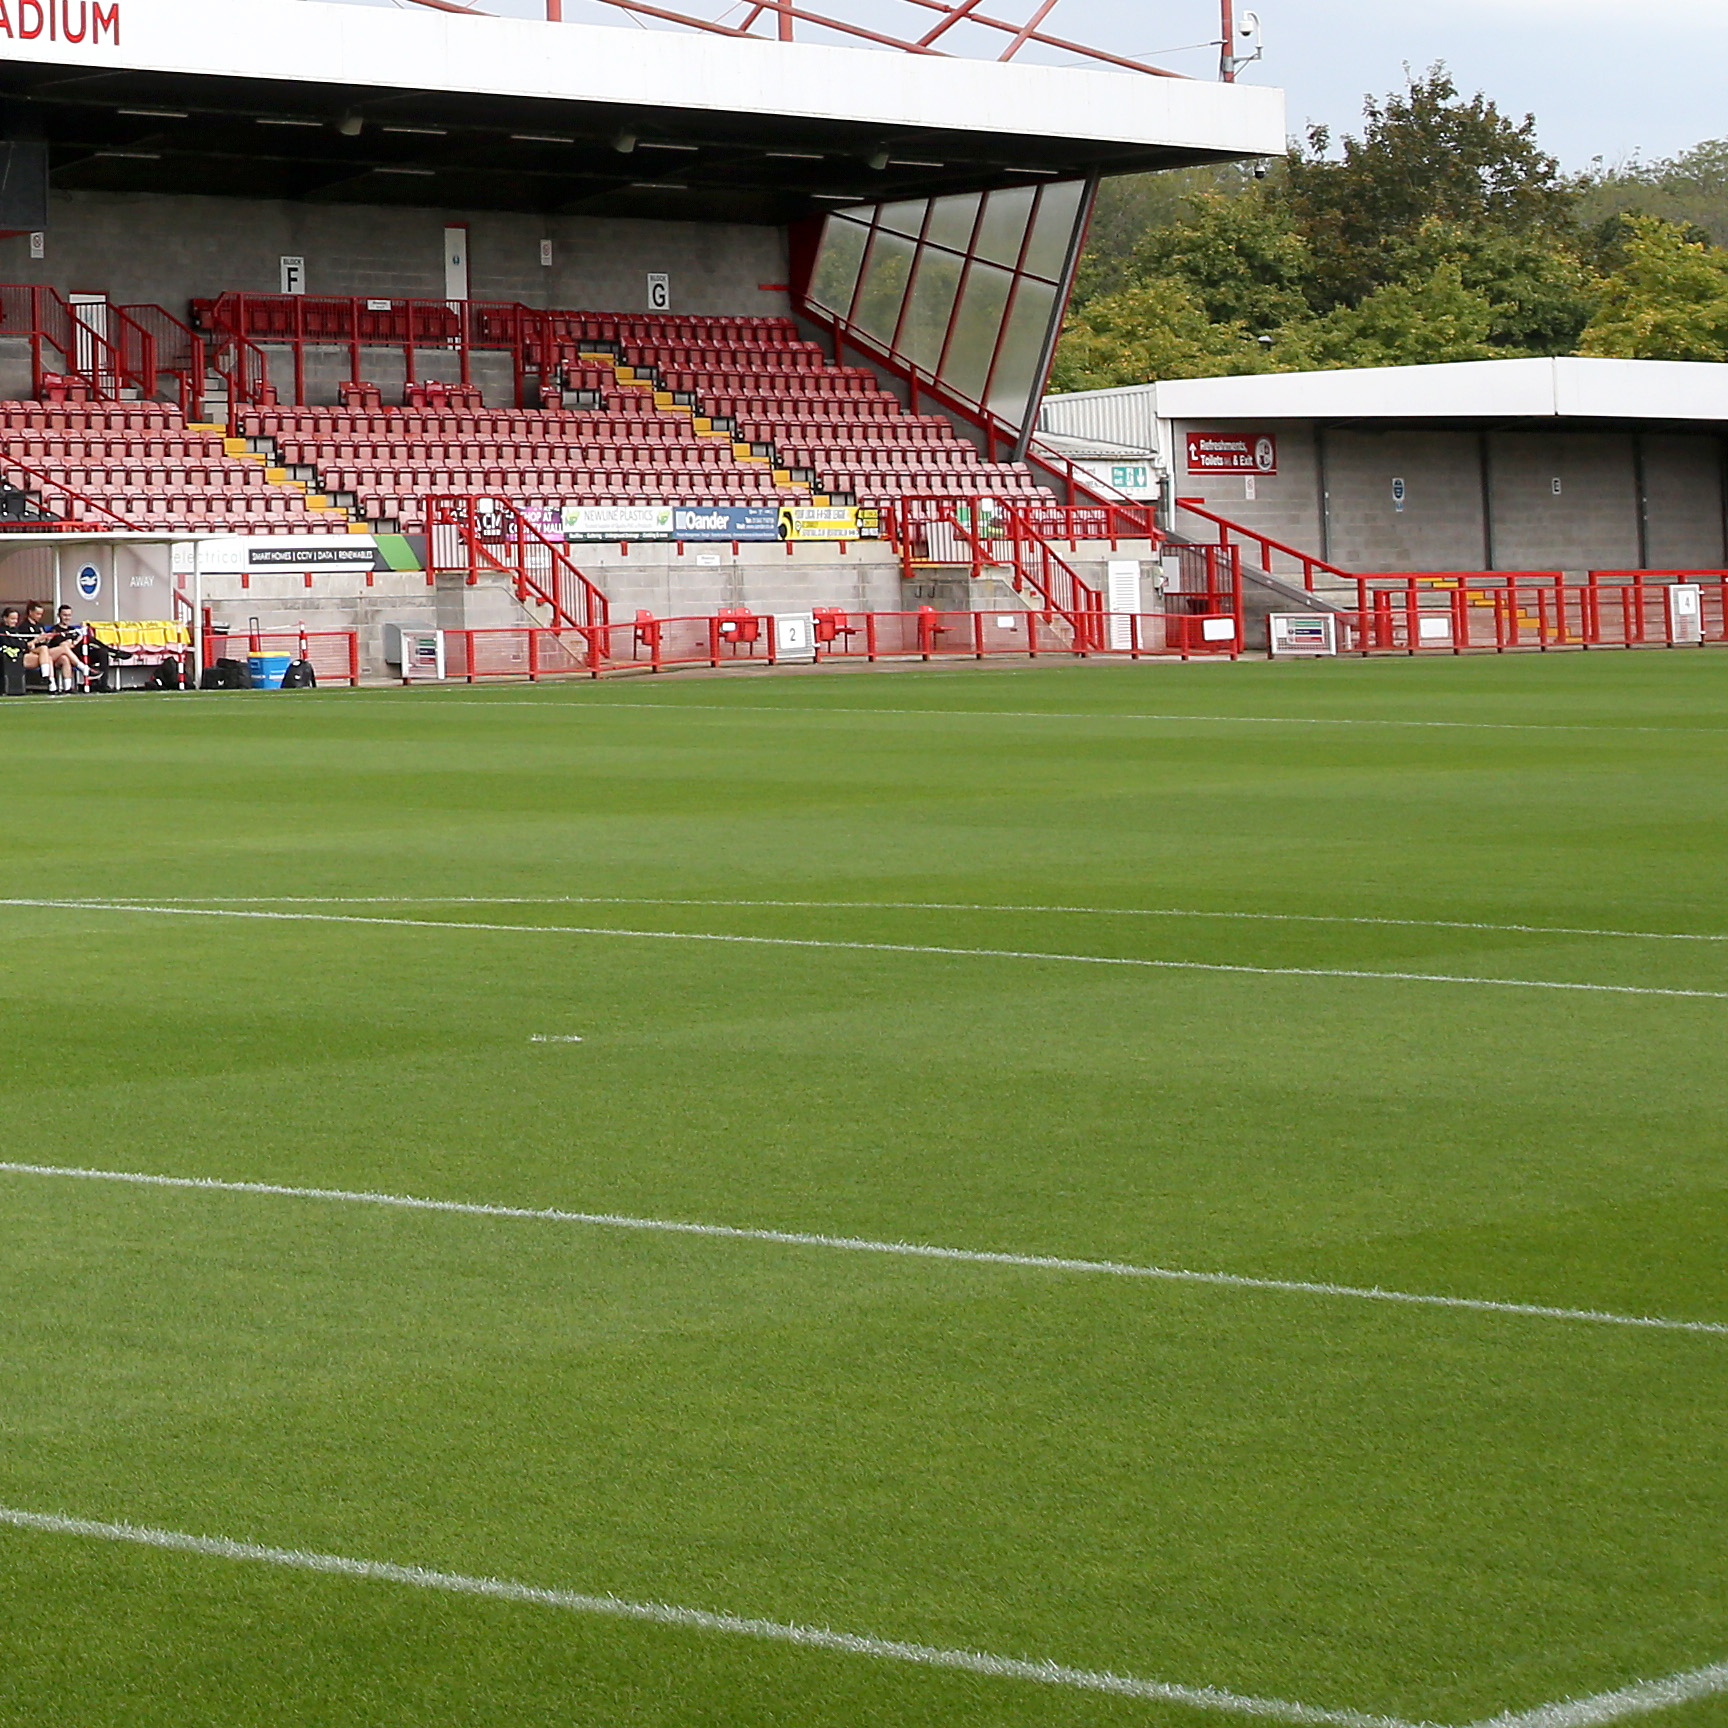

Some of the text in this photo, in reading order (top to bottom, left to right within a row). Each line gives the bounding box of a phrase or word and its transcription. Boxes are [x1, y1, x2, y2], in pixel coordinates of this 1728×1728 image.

[287, 267, 298, 292] F
[652, 283, 666, 307] G
[1200, 455, 1223, 466] Toilets
[1239, 455, 1253, 466] Exit
[686, 511, 730, 530] Oander
[252, 551, 271, 561] SMART
[272, 551, 291, 561] HOMES
[297, 550, 313, 560] CCTV
[317, 550, 333, 560] DATA
[130, 575, 155, 587] AWAY
[789, 627, 796, 641] 2
